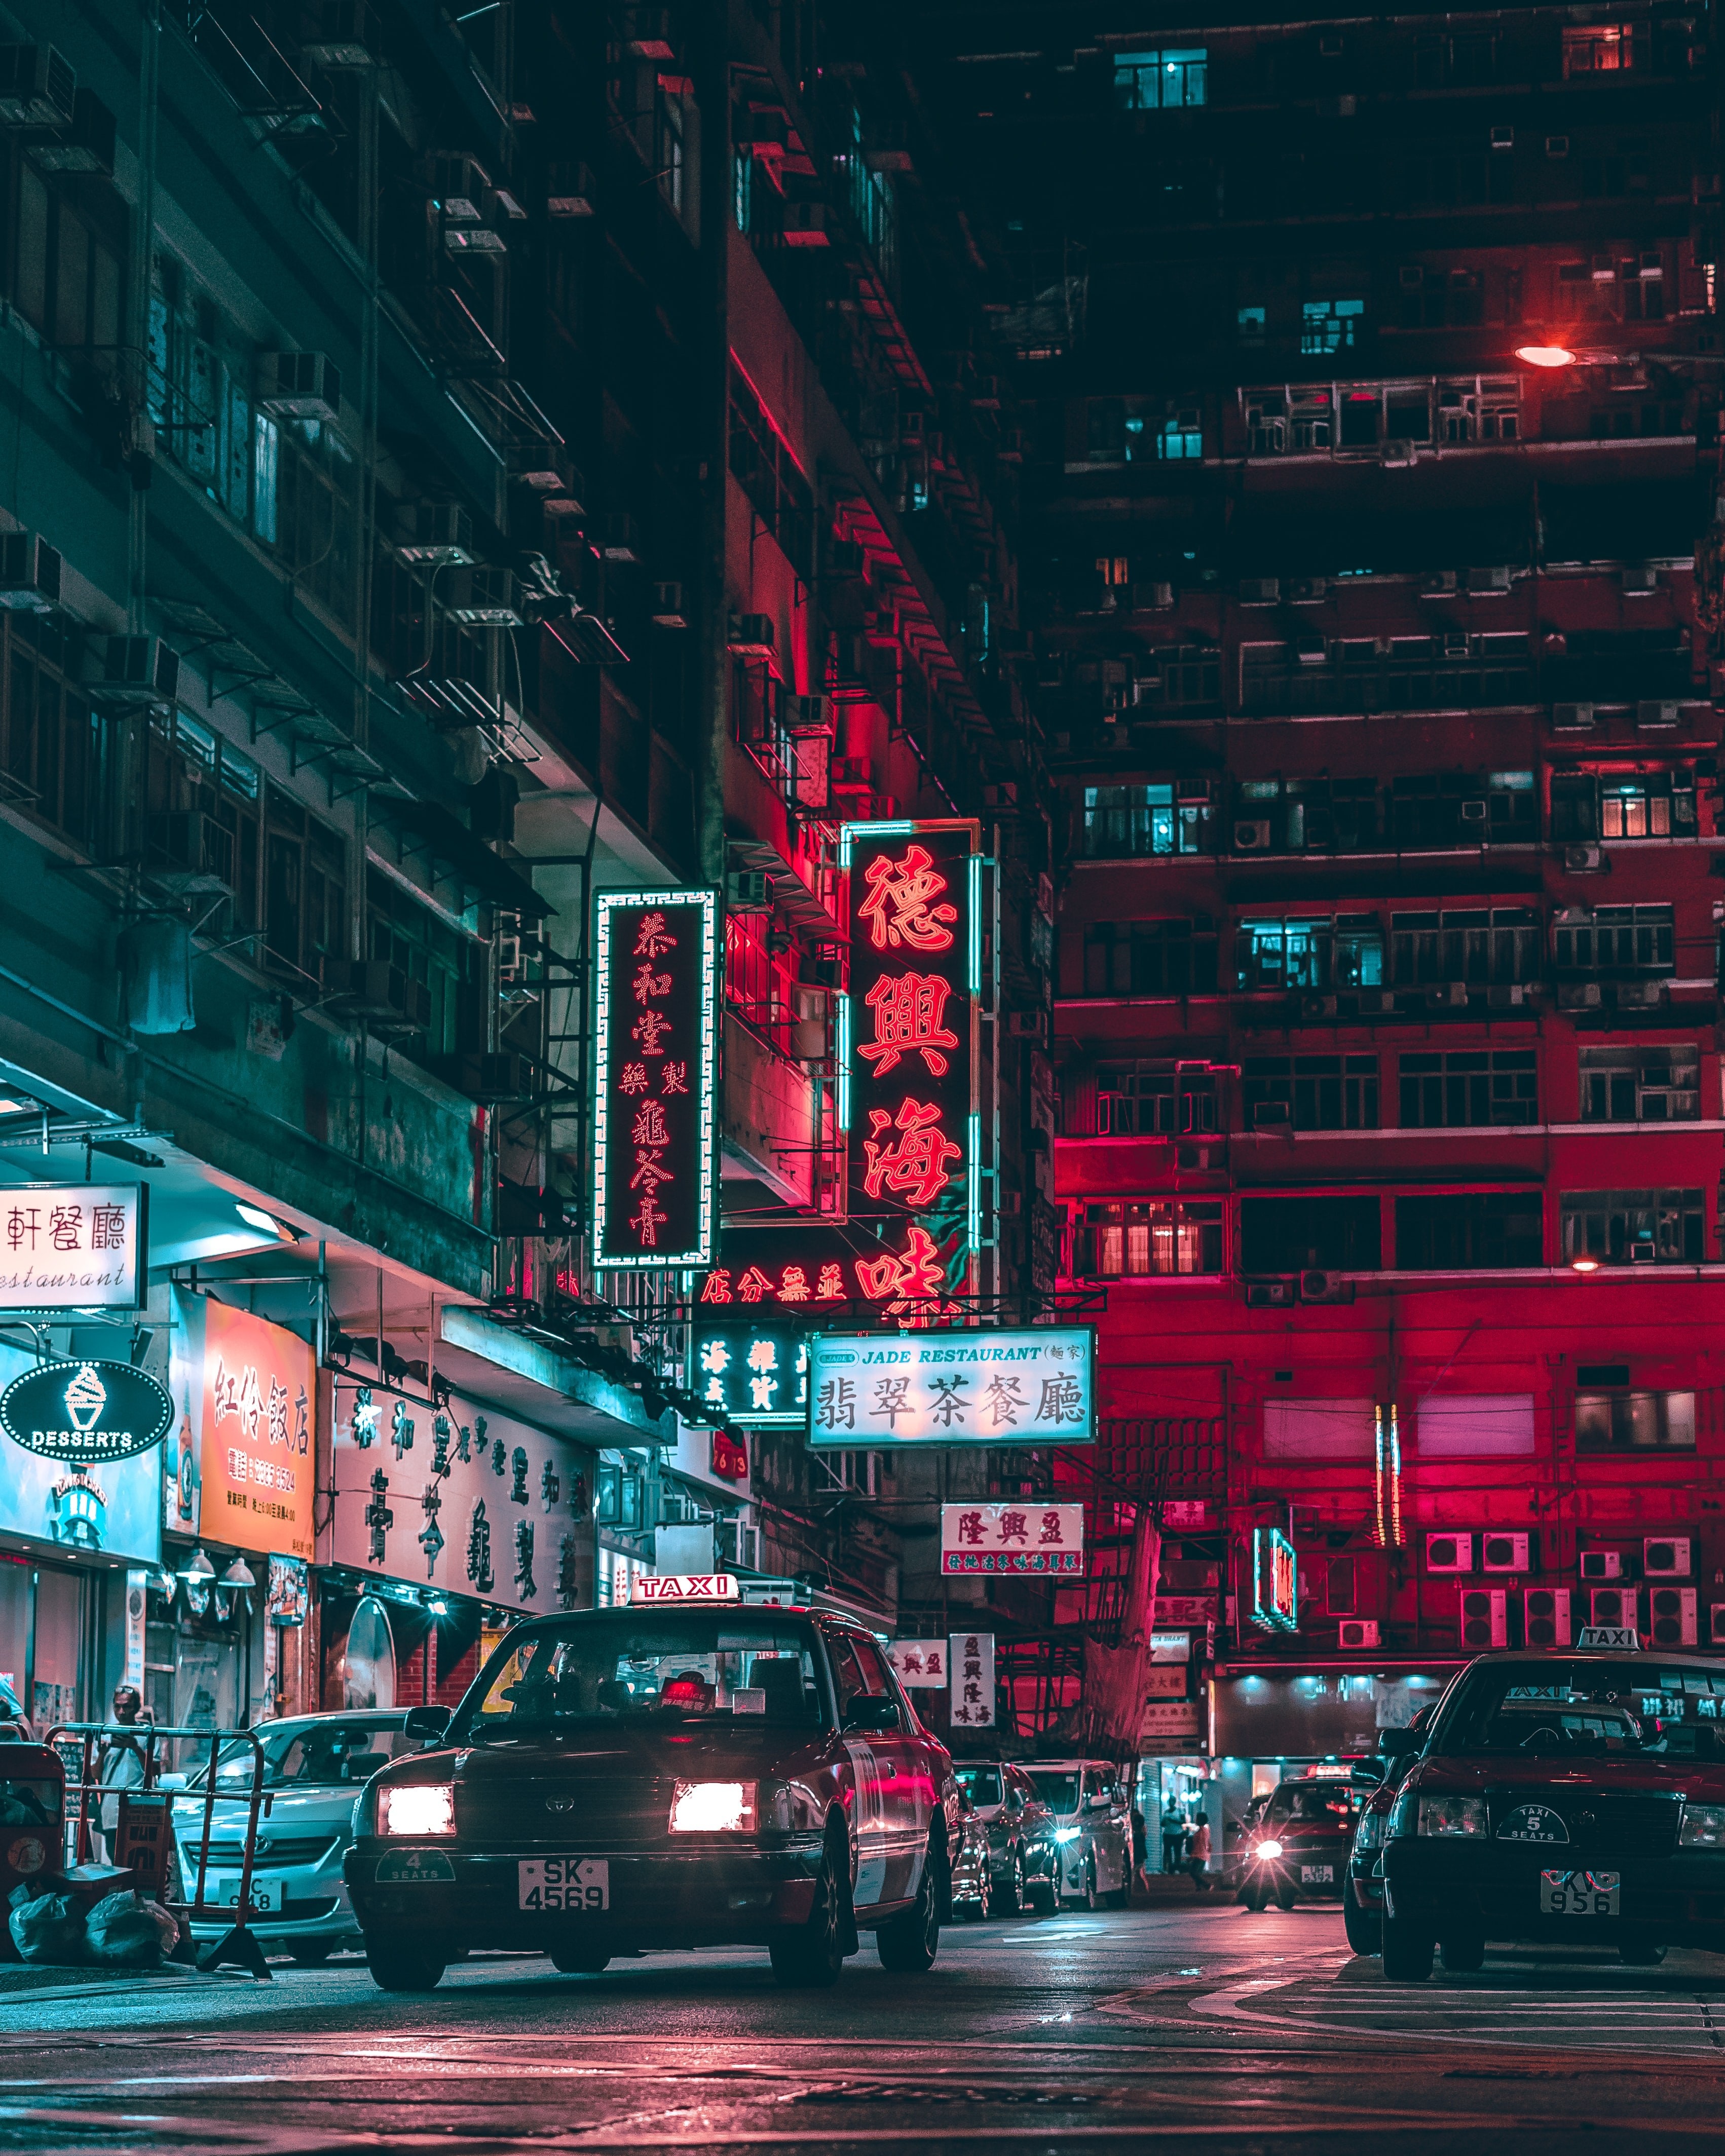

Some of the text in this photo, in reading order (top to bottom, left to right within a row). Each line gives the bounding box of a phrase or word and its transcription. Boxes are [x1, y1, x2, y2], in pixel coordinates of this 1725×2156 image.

[856, 845, 962, 1328] 德興海味
[7, 1201, 125, 1251] 軒餐廳
[862, 1350, 911, 1365] JADE
[919, 1346, 1042, 1363] RESTAURANT
[815, 1371, 1086, 1430] 翡翠茶餐廳
[31, 1430, 133, 1449] DESSERTS
[639, 1576, 728, 1598] TAXI
[1586, 1630, 1632, 1645] TAXI
[1507, 1686, 1560, 1697] AXI
[1520, 1807, 1549, 1818] TAXI
[1526, 1817, 1540, 1830] 5
[1511, 1831, 1554, 1840] SEATS
[405, 1852, 421, 1869] 4
[392, 1870, 438, 1879] SEATS
[544, 1860, 582, 1884] SK
[525, 1886, 603, 1910] 4569
[1550, 1891, 1610, 1914] 956
